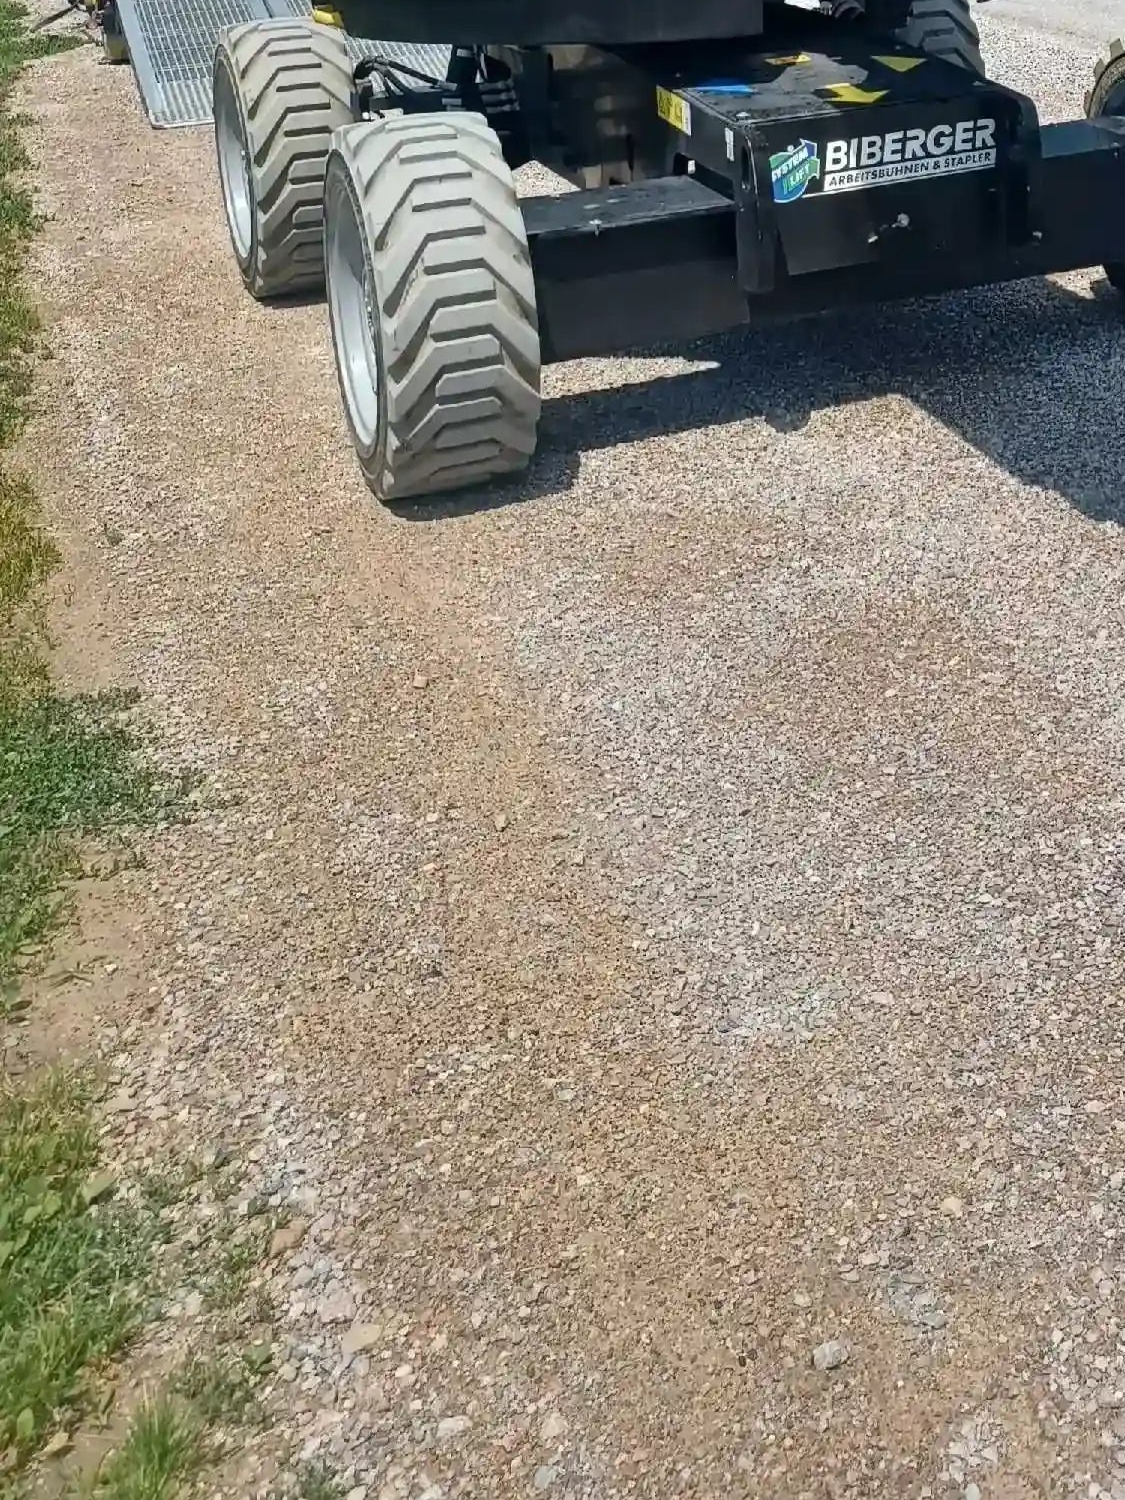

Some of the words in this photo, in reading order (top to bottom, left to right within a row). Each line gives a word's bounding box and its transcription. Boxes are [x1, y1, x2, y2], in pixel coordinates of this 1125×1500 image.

[825, 118, 997, 172] BIBERGER
[932, 159, 942, 171] &
[943, 151, 992, 169] STAPLER
